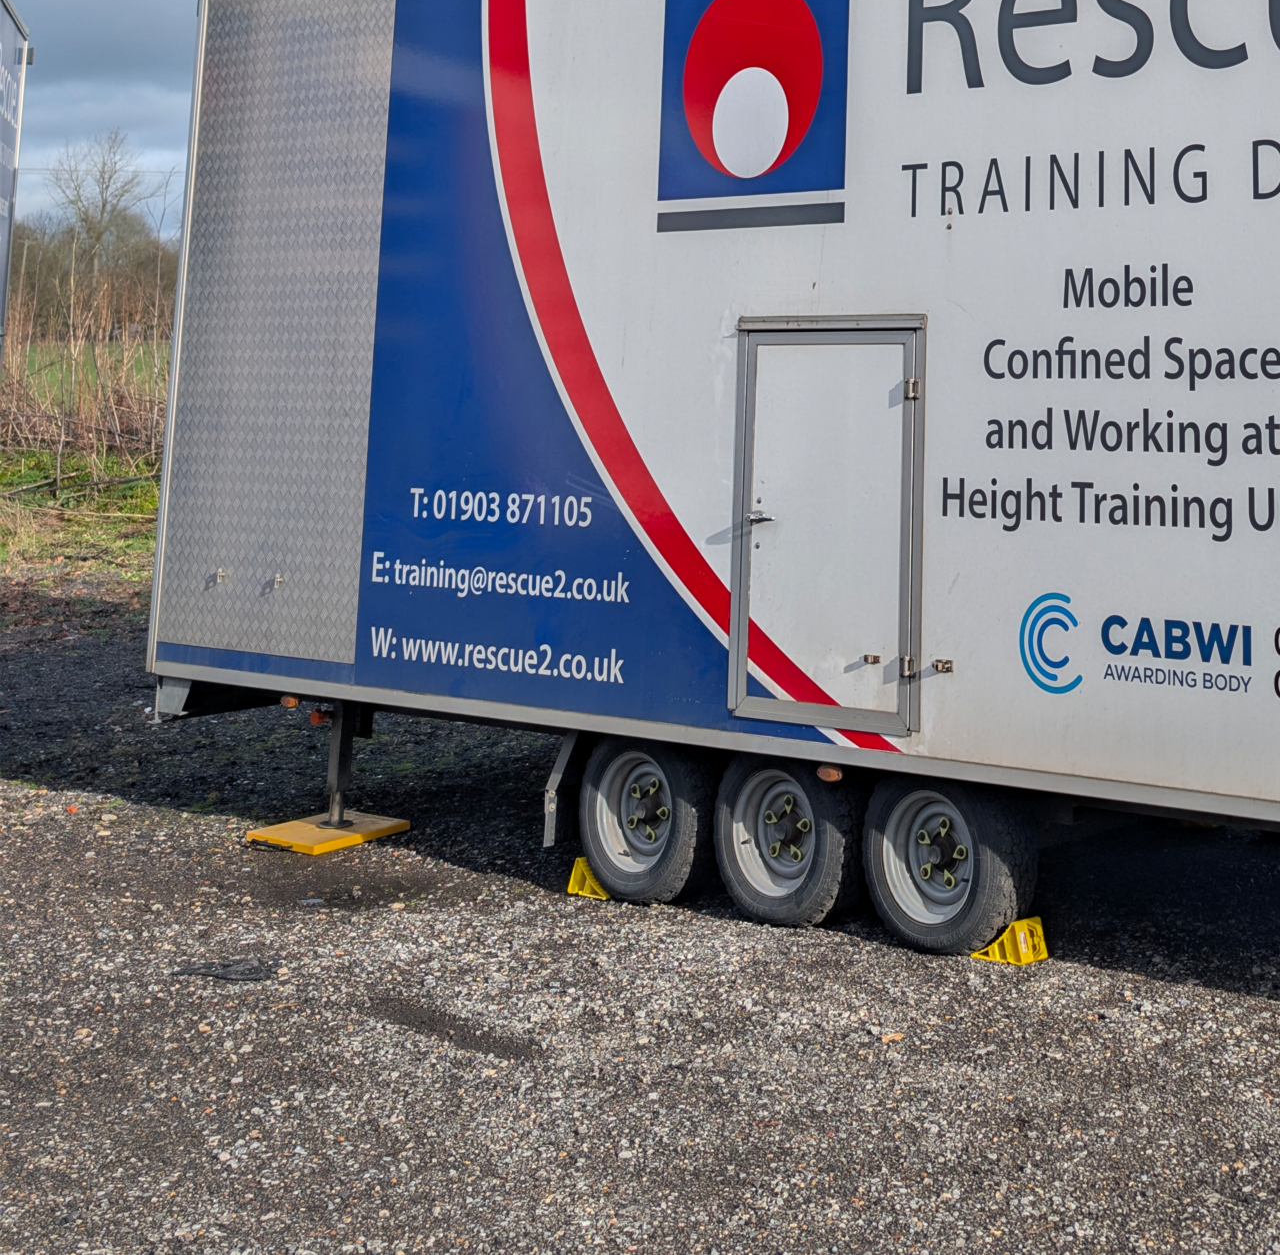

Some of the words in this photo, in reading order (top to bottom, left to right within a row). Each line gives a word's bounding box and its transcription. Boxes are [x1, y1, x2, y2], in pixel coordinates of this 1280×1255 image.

[902, 144, 1207, 217] TRAINING
[1063, 263, 1193, 308] Mobile
[984, 336, 1150, 379] Confined
[986, 408, 1052, 450] and
[1064, 409, 1227, 466] Working
[1242, 415, 1280, 455] at
[411, 488, 428, 518] T:
[434, 490, 499, 522] 01903
[507, 494, 592, 527] 871105
[942, 477, 1062, 532] Height
[1071, 482, 1232, 542] Training
[372, 552, 390, 583] E:
[395, 559, 629, 602] training@rescue2.co.uk
[372, 627, 396, 658] W:
[403, 638, 623, 683] www.rescue2.co.uk
[1101, 615, 1252, 666] CABWI
[1103, 664, 1197, 689] AWARDING
[1203, 672, 1252, 694] BODY
